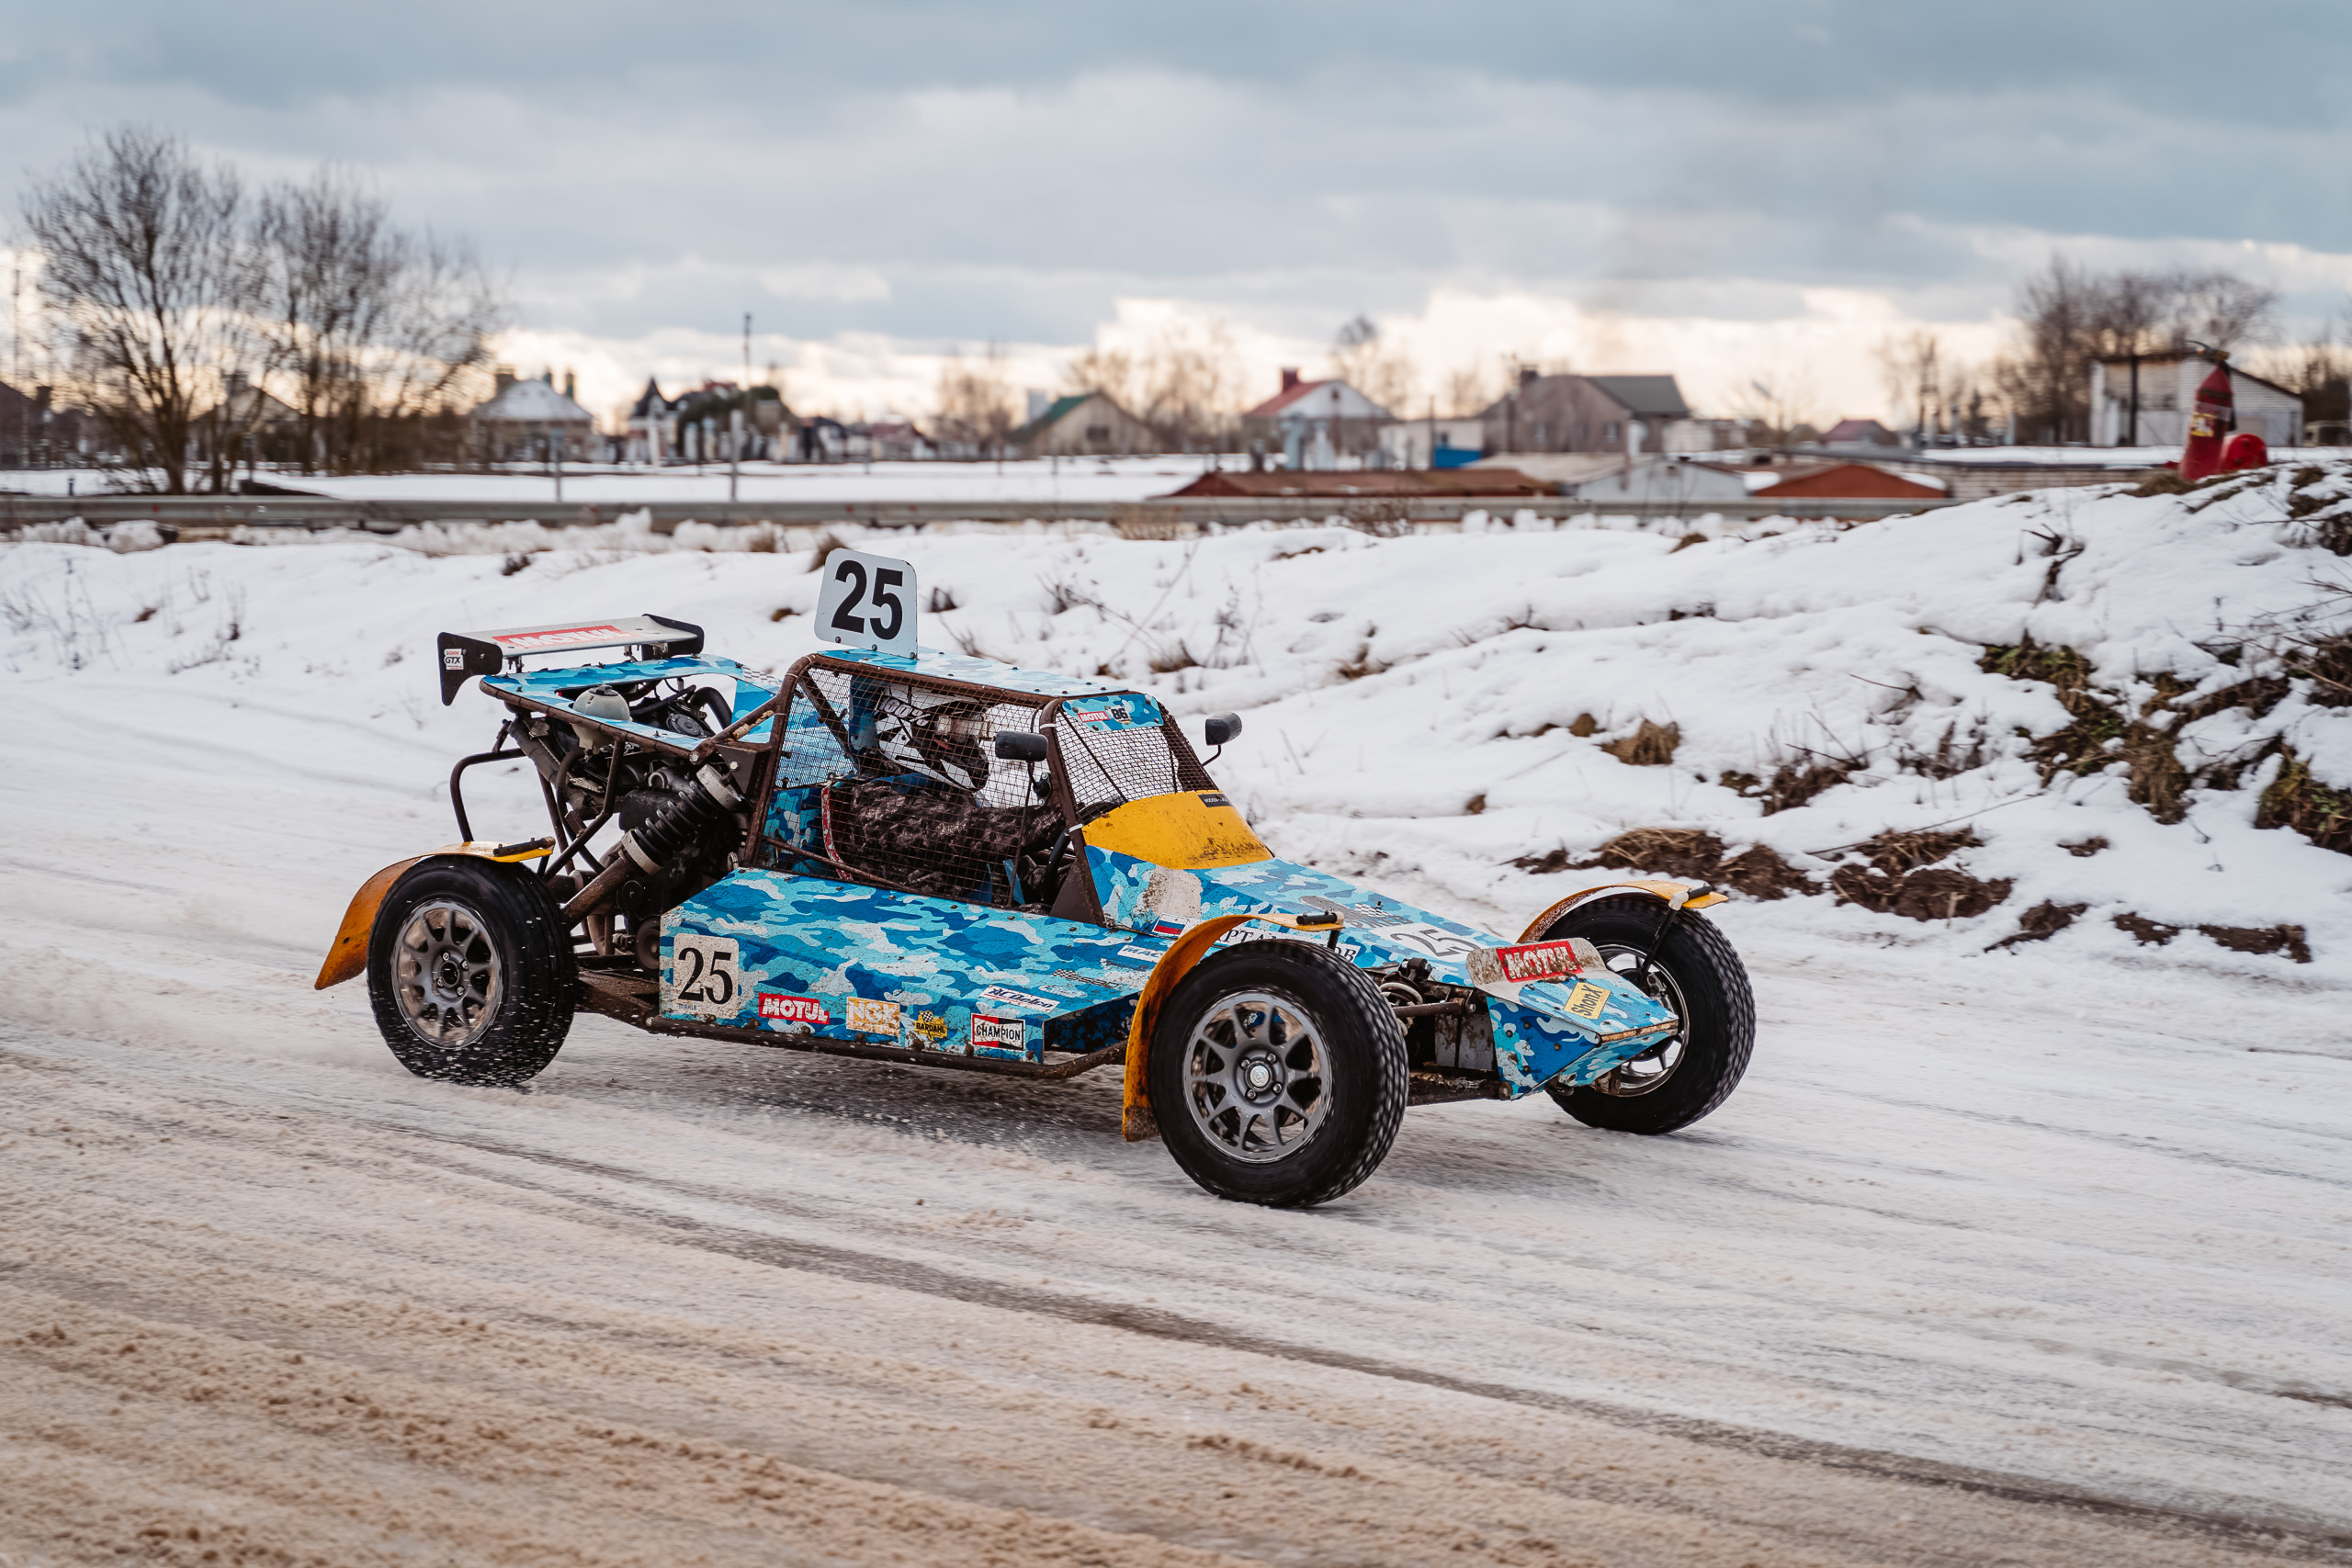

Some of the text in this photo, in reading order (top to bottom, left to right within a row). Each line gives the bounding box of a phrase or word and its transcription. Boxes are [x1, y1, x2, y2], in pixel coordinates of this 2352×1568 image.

[831, 559, 903, 640] 25
[509, 628, 632, 648] MOTUL
[445, 656, 461, 664] GTX
[1080, 712, 1108, 721] MOTUL
[1111, 708, 1129, 719] 86
[1390, 929, 1482, 957] 25
[1505, 946, 1578, 980] MOTUL
[678, 947, 733, 1005] 25
[762, 998, 829, 1021] MOTUL
[988, 987, 1054, 1010] ACDelco
[1571, 985, 1602, 1017] ShonX
[848, 1000, 899, 1023] NGK
[915, 1021, 946, 1033] BARDAHL
[976, 1024, 1021, 1041] CHAMPION
